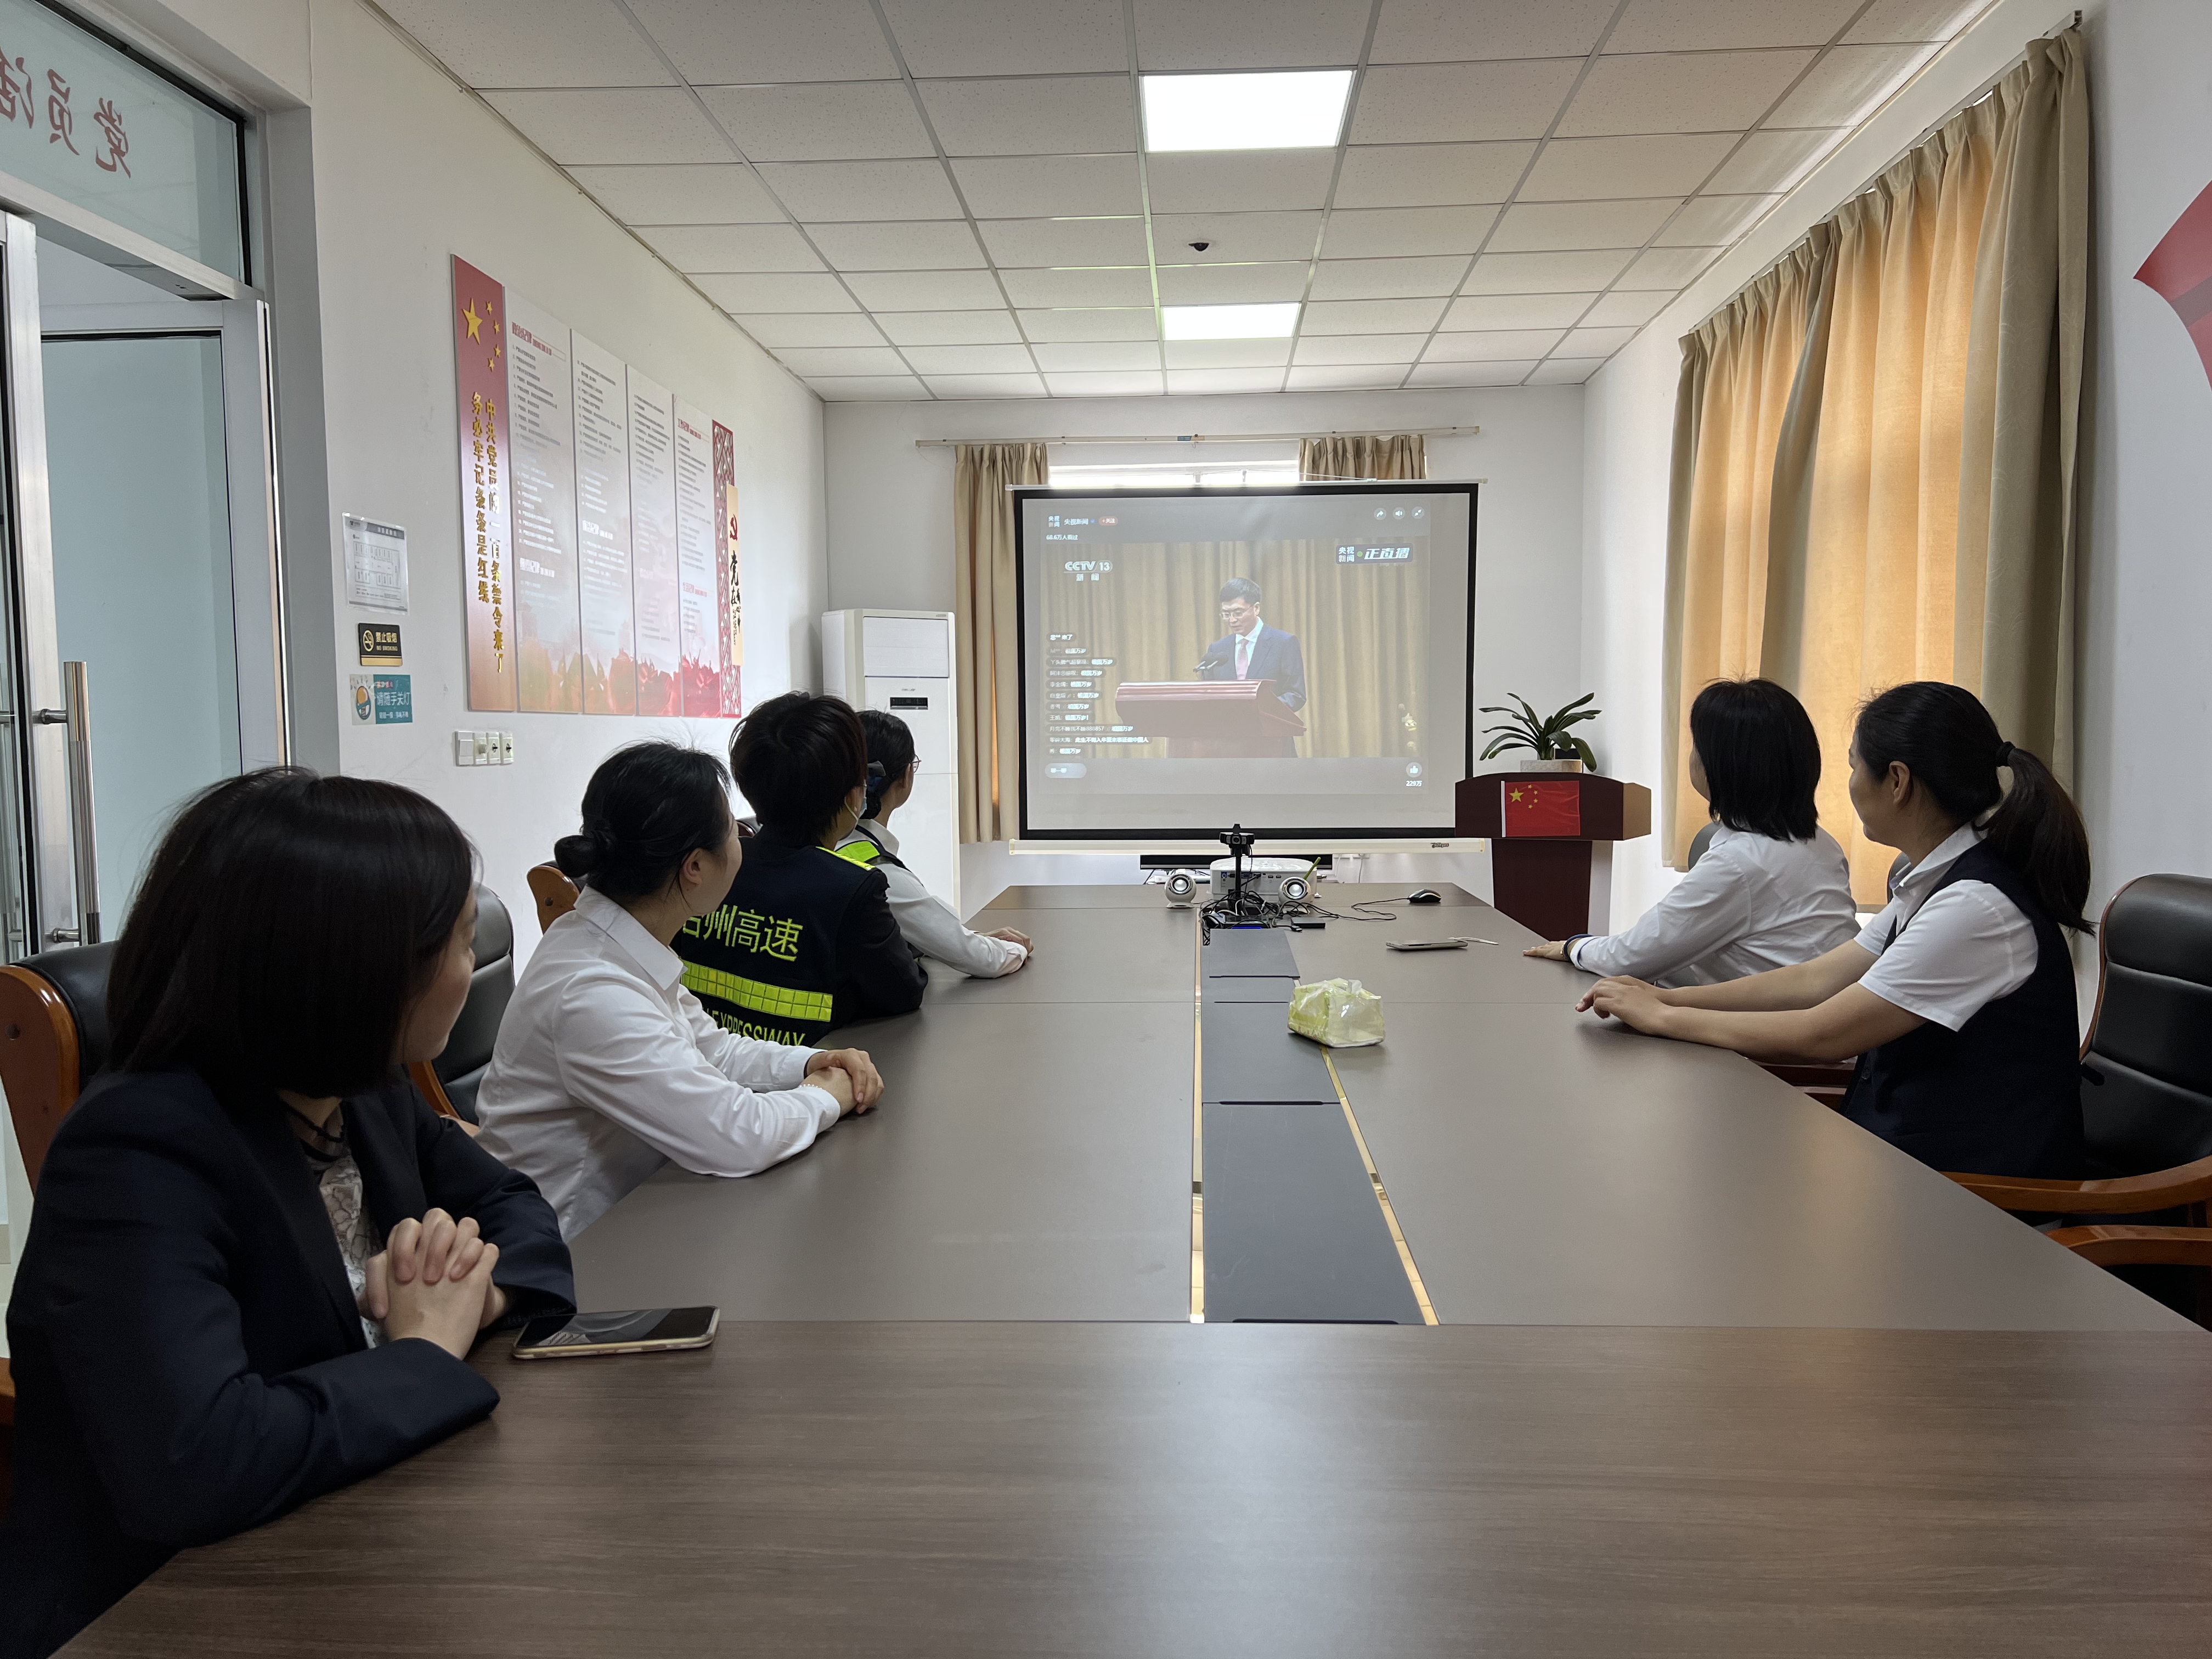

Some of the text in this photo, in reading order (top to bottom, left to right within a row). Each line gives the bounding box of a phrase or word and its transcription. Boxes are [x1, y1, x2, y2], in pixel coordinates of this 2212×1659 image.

[472, 392, 489, 603] 务必牢记条条是红线
[1339, 554, 1355, 562] 新闻
[1364, 548, 1409, 560] 正直播
[1065, 561, 1110, 571] CCTV 13
[376, 632, 397, 642] 禁止吸烟
[377, 692, 410, 706] 请随手关灯
